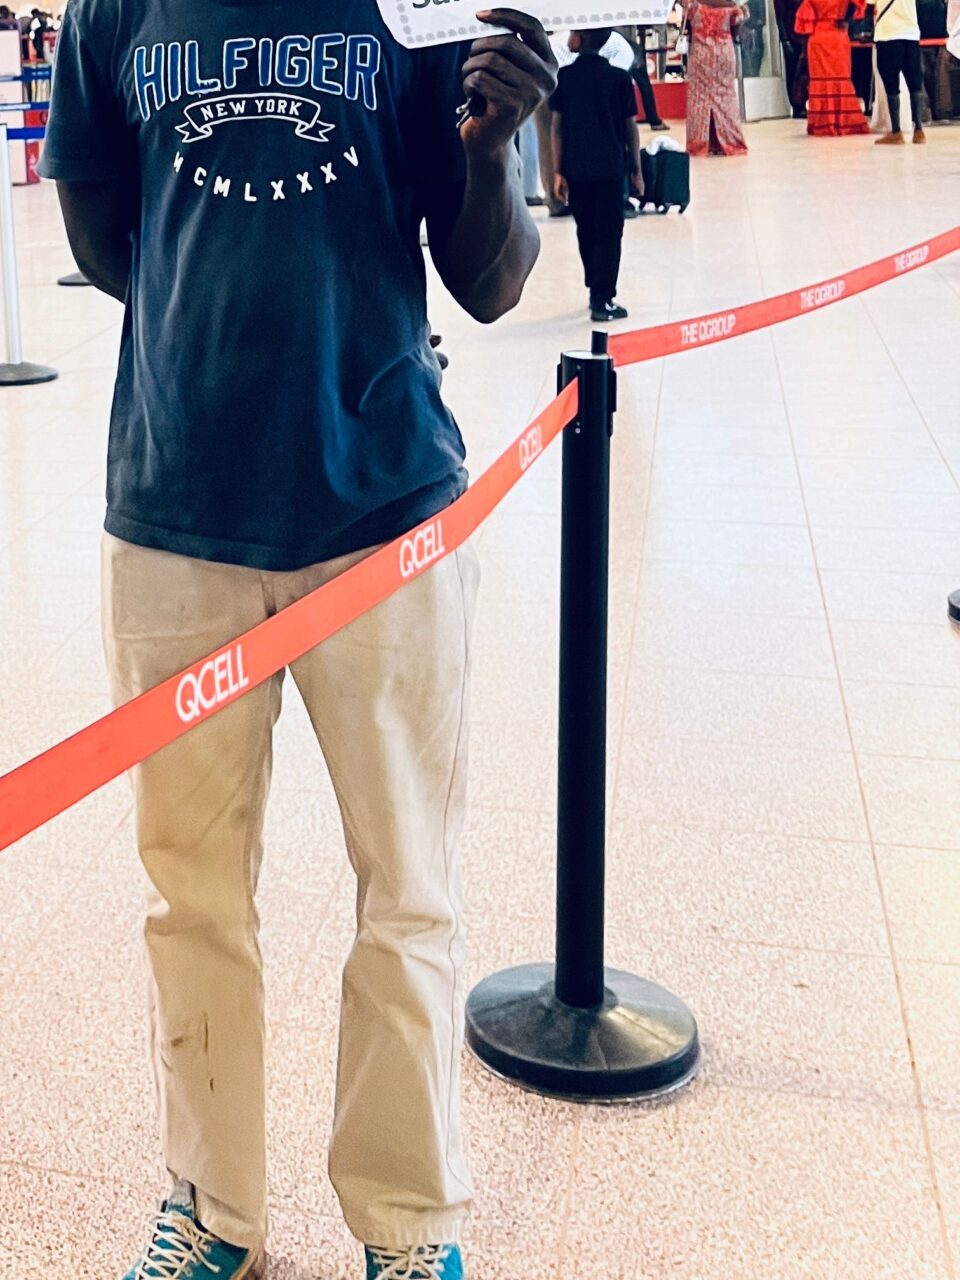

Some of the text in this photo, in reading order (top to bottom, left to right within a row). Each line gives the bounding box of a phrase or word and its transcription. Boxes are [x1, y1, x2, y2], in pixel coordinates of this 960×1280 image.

[134, 33, 381, 121] HILFIGER
[200, 98, 302, 121] NEW YORK
[680, 323, 698, 345] THE
[518, 423, 543, 471] QCELL
[399, 518, 445, 579] QCELL
[175, 644, 249, 722] QCELL
